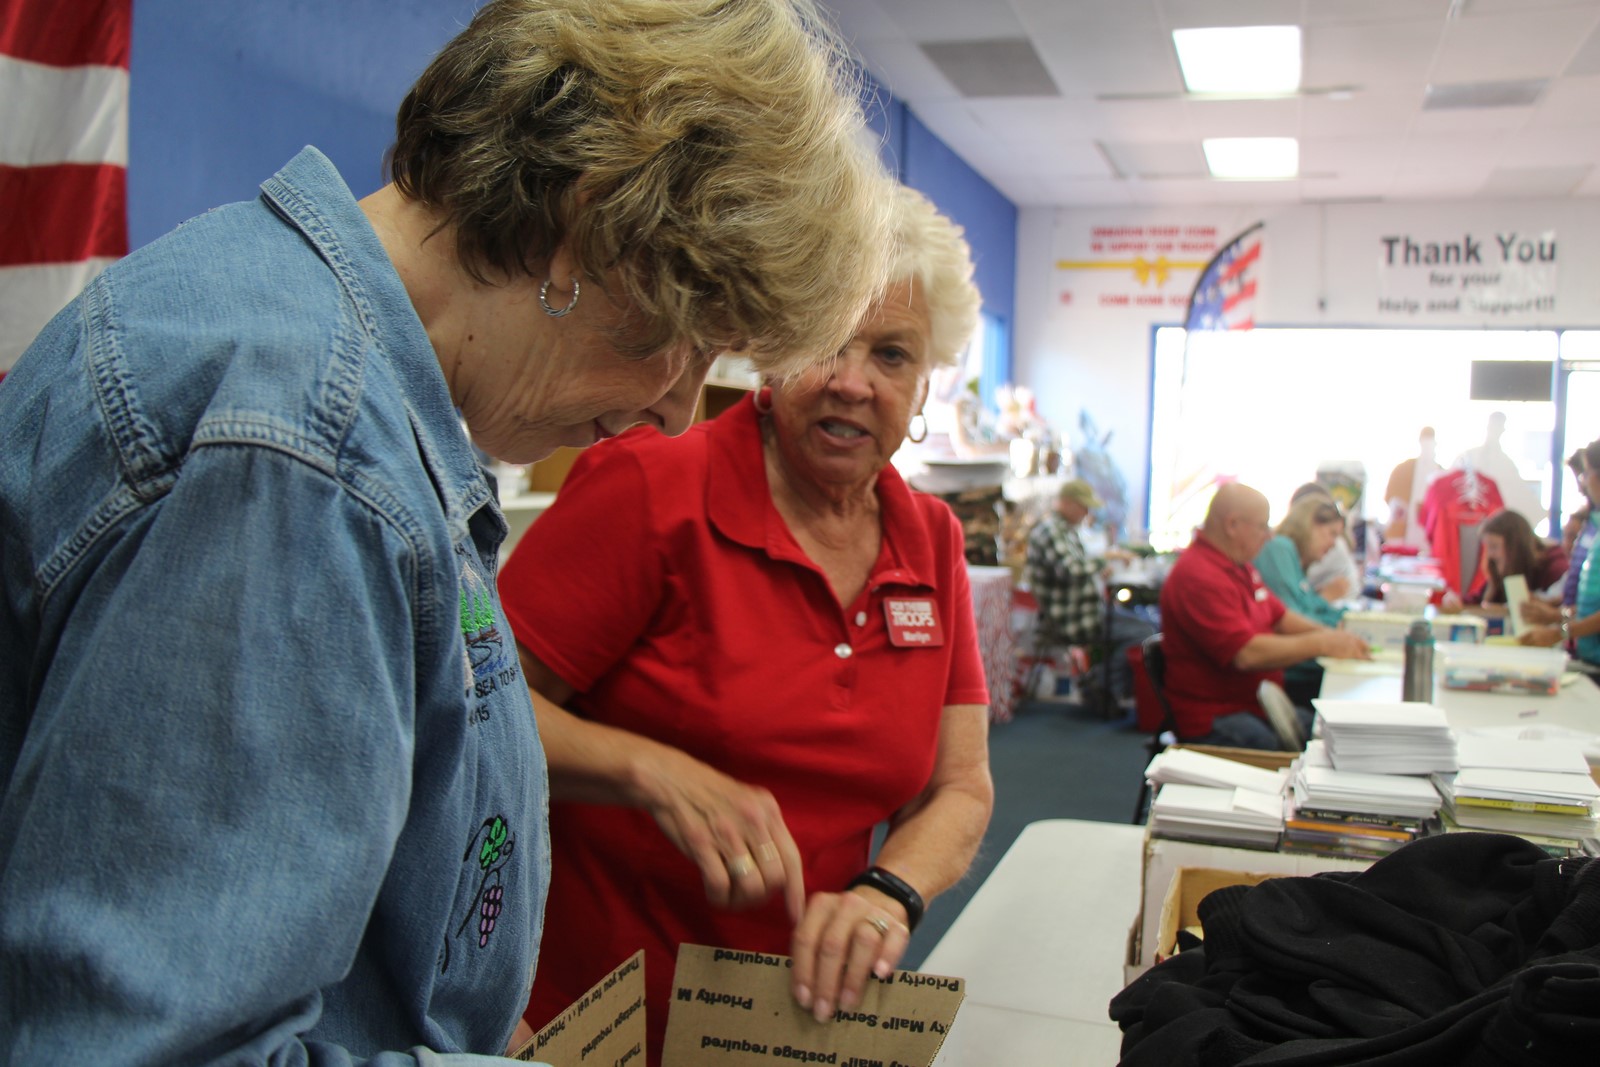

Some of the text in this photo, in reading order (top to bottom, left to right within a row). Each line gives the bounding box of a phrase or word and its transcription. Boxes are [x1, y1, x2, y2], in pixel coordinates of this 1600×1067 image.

[1381, 231, 1556, 266] Thank You
[1429, 271, 1501, 289] for your
[1378, 297, 1420, 314] Help
[1427, 296, 1461, 311] and
[891, 612, 936, 627] TROOPS
[475, 676, 498, 699] SEA
[714, 949, 780, 967] required
[618, 957, 640, 981] Thank
[603, 972, 617, 992] you
[899, 972, 959, 992] Priority
[591, 986, 602, 1003] for
[695, 988, 753, 1010] Priority
[537, 1015, 566, 1050] Priority
[580, 996, 642, 1061] postage required
[930, 1020, 949, 1035] ty
[701, 1036, 768, 1054] required
[773, 1046, 838, 1065] postage
